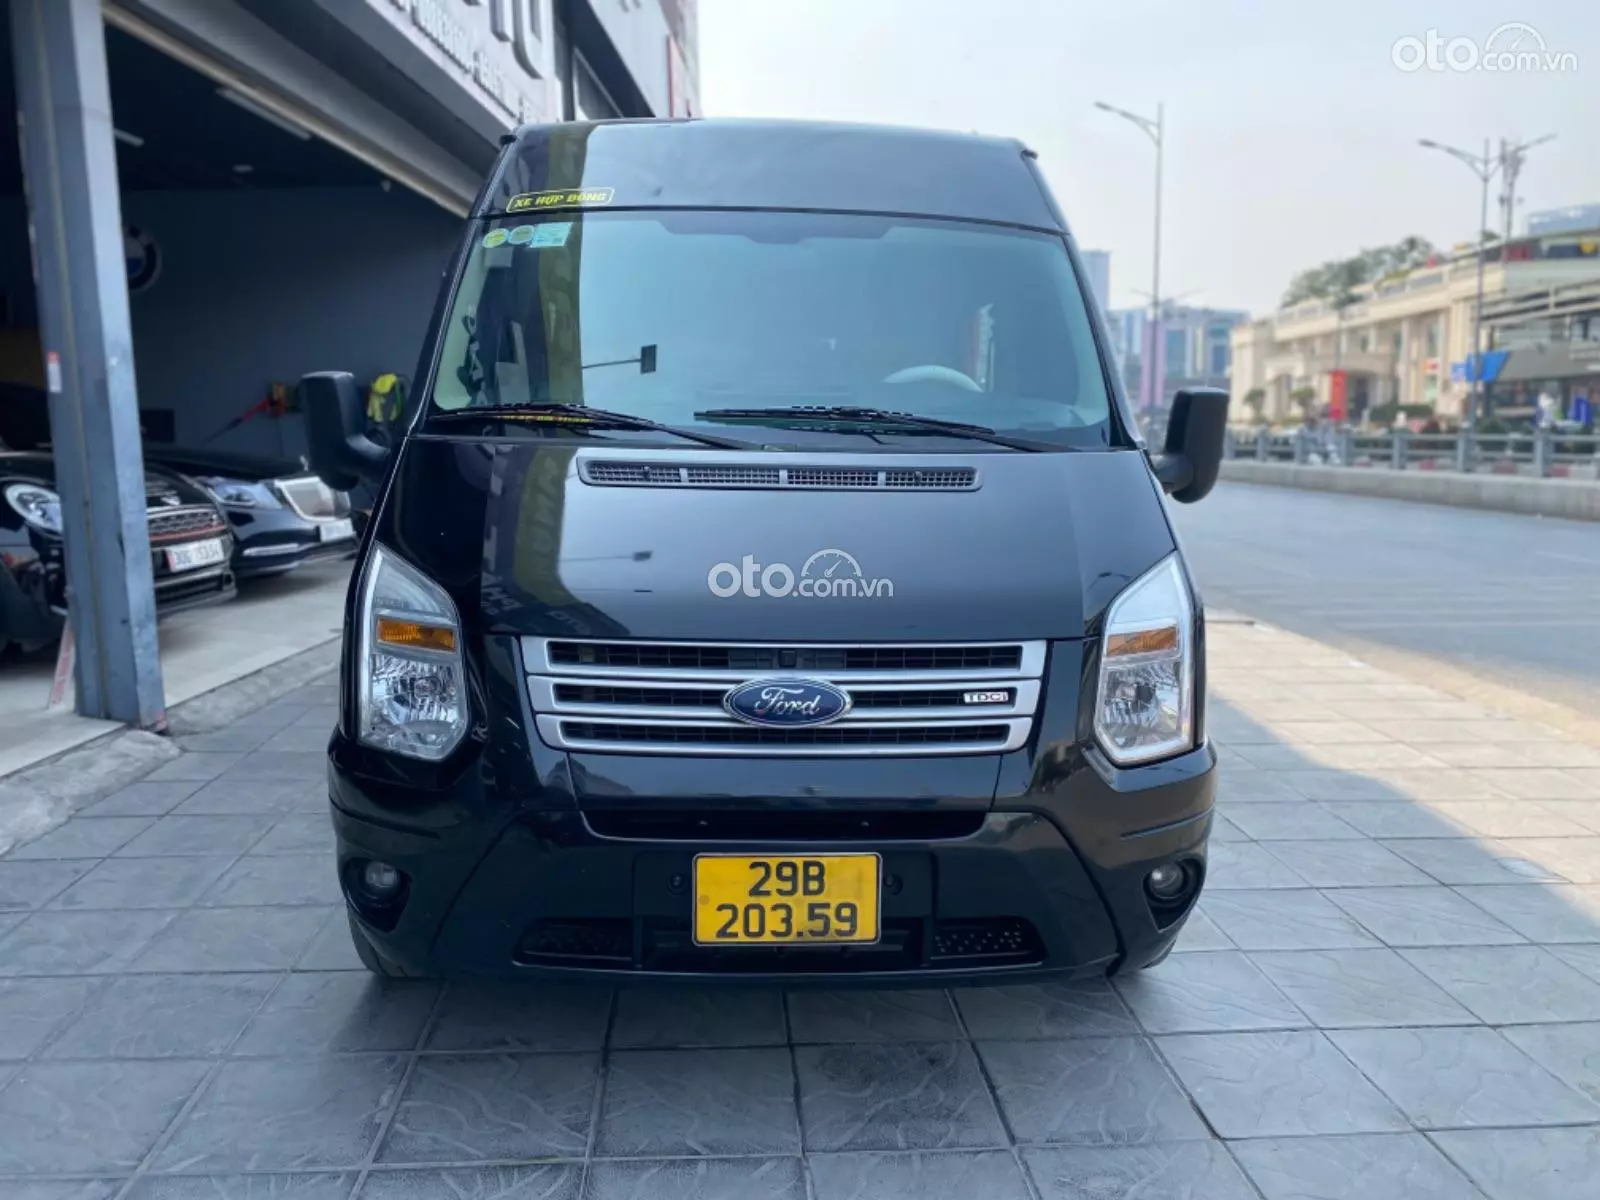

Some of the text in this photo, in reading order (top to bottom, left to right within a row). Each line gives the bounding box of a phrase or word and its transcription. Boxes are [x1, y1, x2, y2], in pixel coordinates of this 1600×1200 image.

[515, 199, 532, 208] XE
[753, 686, 821, 716] Ford
[748, 860, 826, 897] 29B
[715, 902, 858, 939] 203.59
